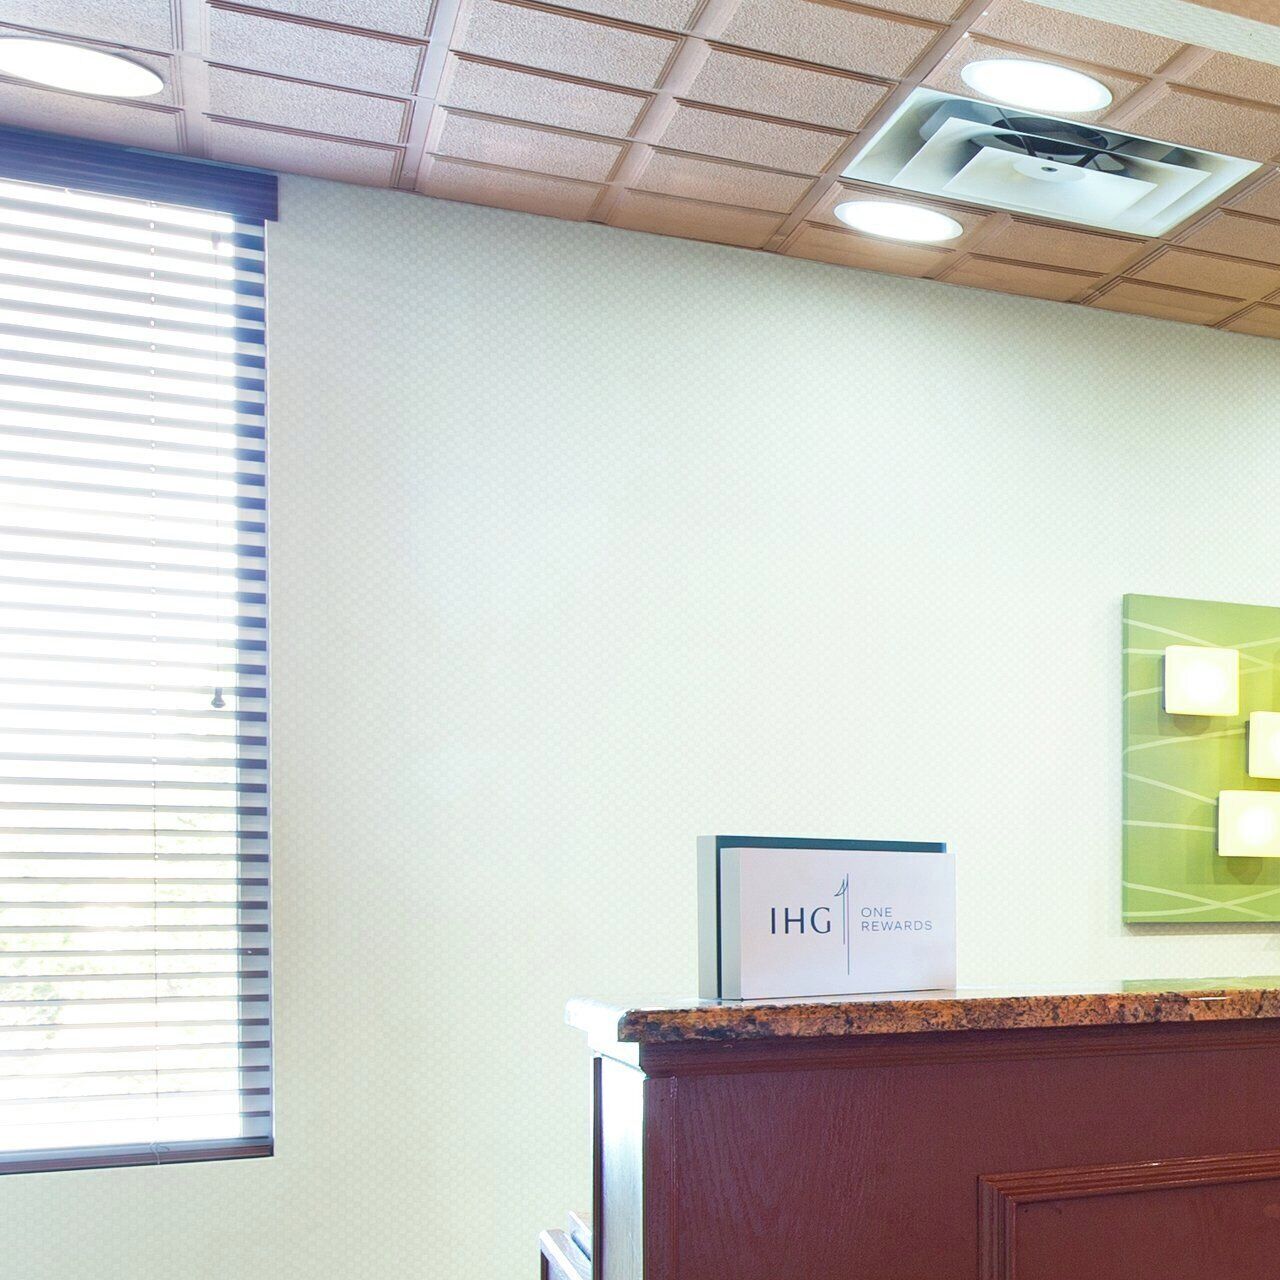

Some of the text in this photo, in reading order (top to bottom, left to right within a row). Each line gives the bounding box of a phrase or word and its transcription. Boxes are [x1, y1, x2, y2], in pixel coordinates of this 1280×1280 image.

[861, 907, 892, 918] ONE
[771, 906, 831, 934] IHG
[861, 920, 933, 932] REWARDS
